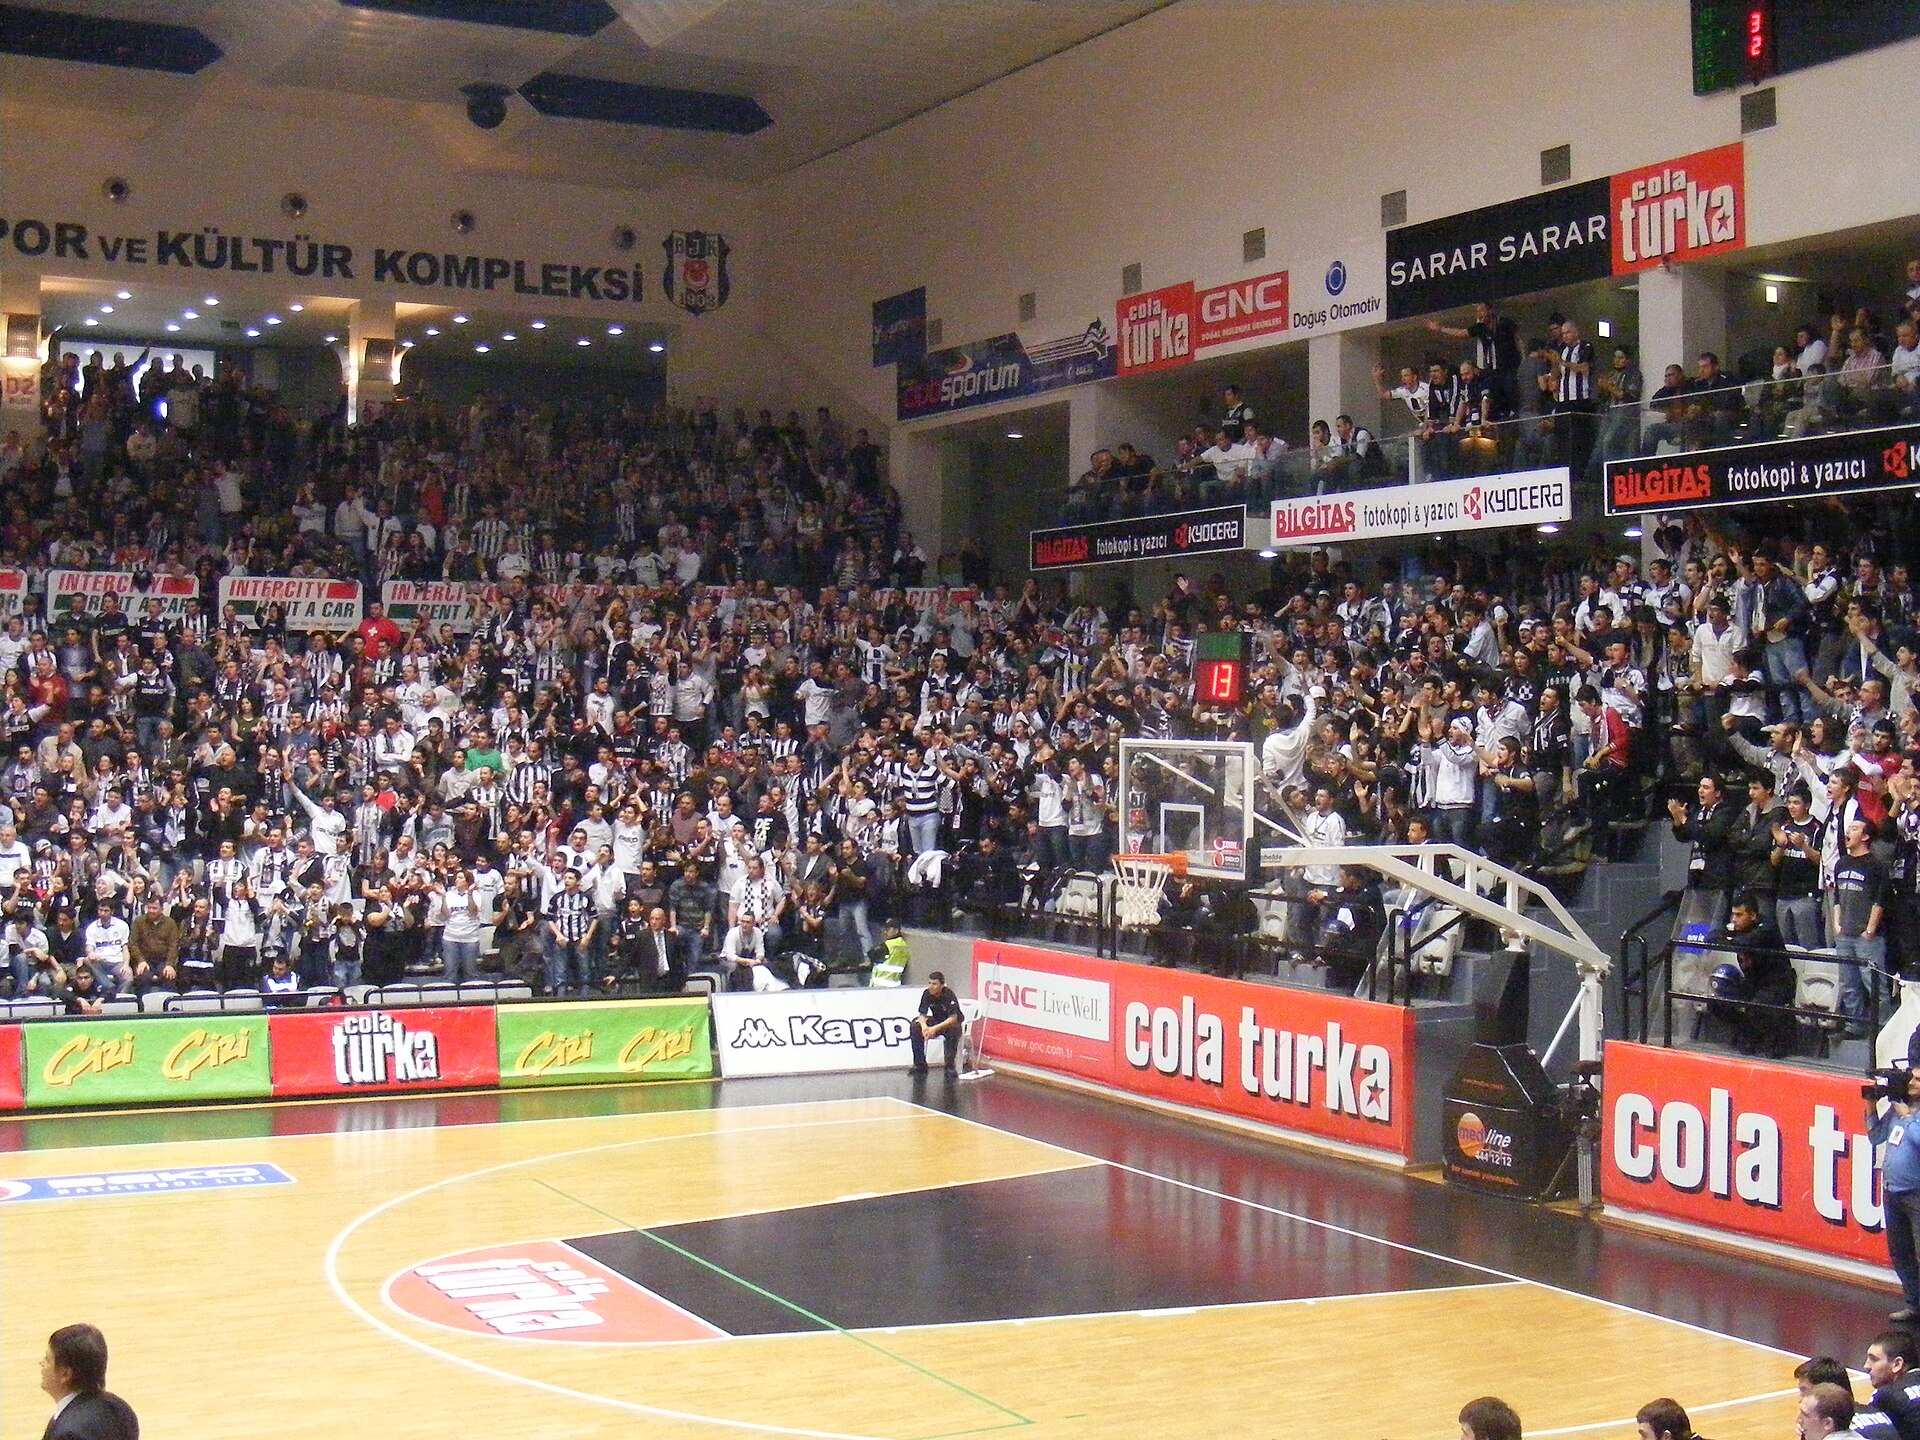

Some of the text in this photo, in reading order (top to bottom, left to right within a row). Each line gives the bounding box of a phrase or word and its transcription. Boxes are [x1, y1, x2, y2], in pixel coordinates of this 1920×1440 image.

[1751, 11, 1761, 34] 3
[1750, 35, 1762, 56] 2
[1631, 168, 1687, 202] cola
[1620, 180, 1736, 263] turka
[0, 219, 643, 302] OR VE KÜLTÜR KOMPLEKSİ
[1390, 214, 1608, 286] SARAR SARAR
[1128, 297, 1162, 321] cola
[1201, 277, 1281, 324] GNC
[1293, 296, 1381, 330] Doğuş Otomotiv
[1121, 309, 1190, 368] turka
[1727, 460, 1796, 491] fotokopi
[1800, 468, 1810, 483] &
[1814, 459, 1867, 489] yazıcı
[1363, 501, 1411, 529] fotokopi
[1414, 507, 1421, 523] &
[1423, 502, 1459, 528] yazıcı
[1483, 482, 1563, 514] KYOCERA
[1096, 534, 1132, 556] fotokopi
[1133, 541, 1139, 551] &
[1140, 535, 1167, 555] yazıcı
[1188, 520, 1239, 544] KYOCERA
[304, 601, 316, 617] A
[321, 602, 355, 618] CAR
[1212, 664, 1233, 698] 13
[984, 979, 1038, 1010] GNC
[344, 1010, 394, 1034] cola
[788, 1014, 912, 1049] Kapp
[331, 1022, 441, 1085] turka
[1125, 994, 1393, 1126] cola turka
[1612, 1086, 1784, 1212] cola
[412, 1257, 605, 1336] turka
